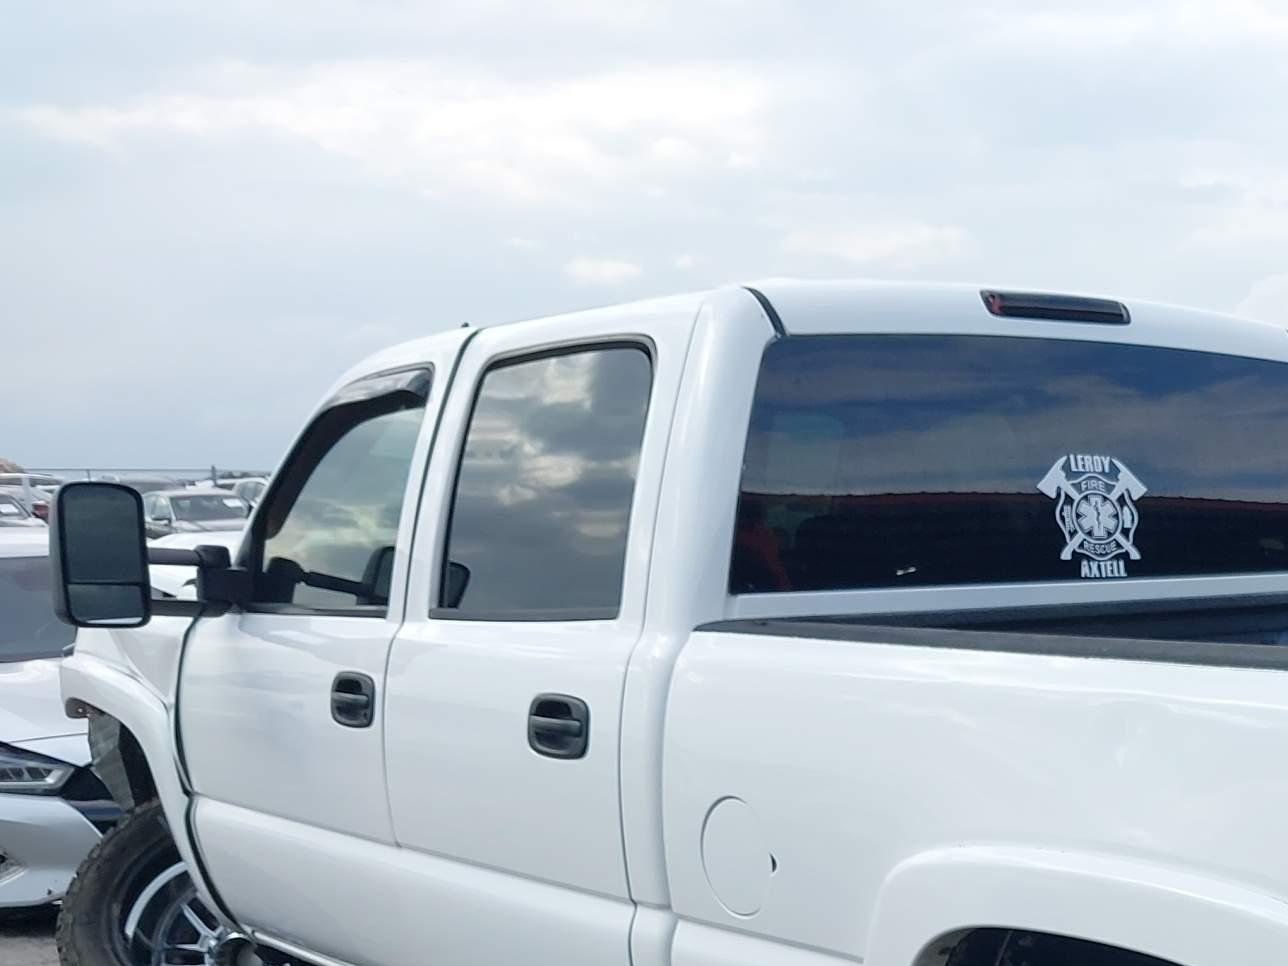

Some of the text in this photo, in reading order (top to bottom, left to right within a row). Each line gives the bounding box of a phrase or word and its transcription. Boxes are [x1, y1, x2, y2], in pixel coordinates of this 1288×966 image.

[1069, 454, 1111, 472] LEROY
[1081, 480, 1106, 492] FIRE
[1083, 540, 1118, 555] RESCUE
[1080, 559, 1128, 578] AXTELL
